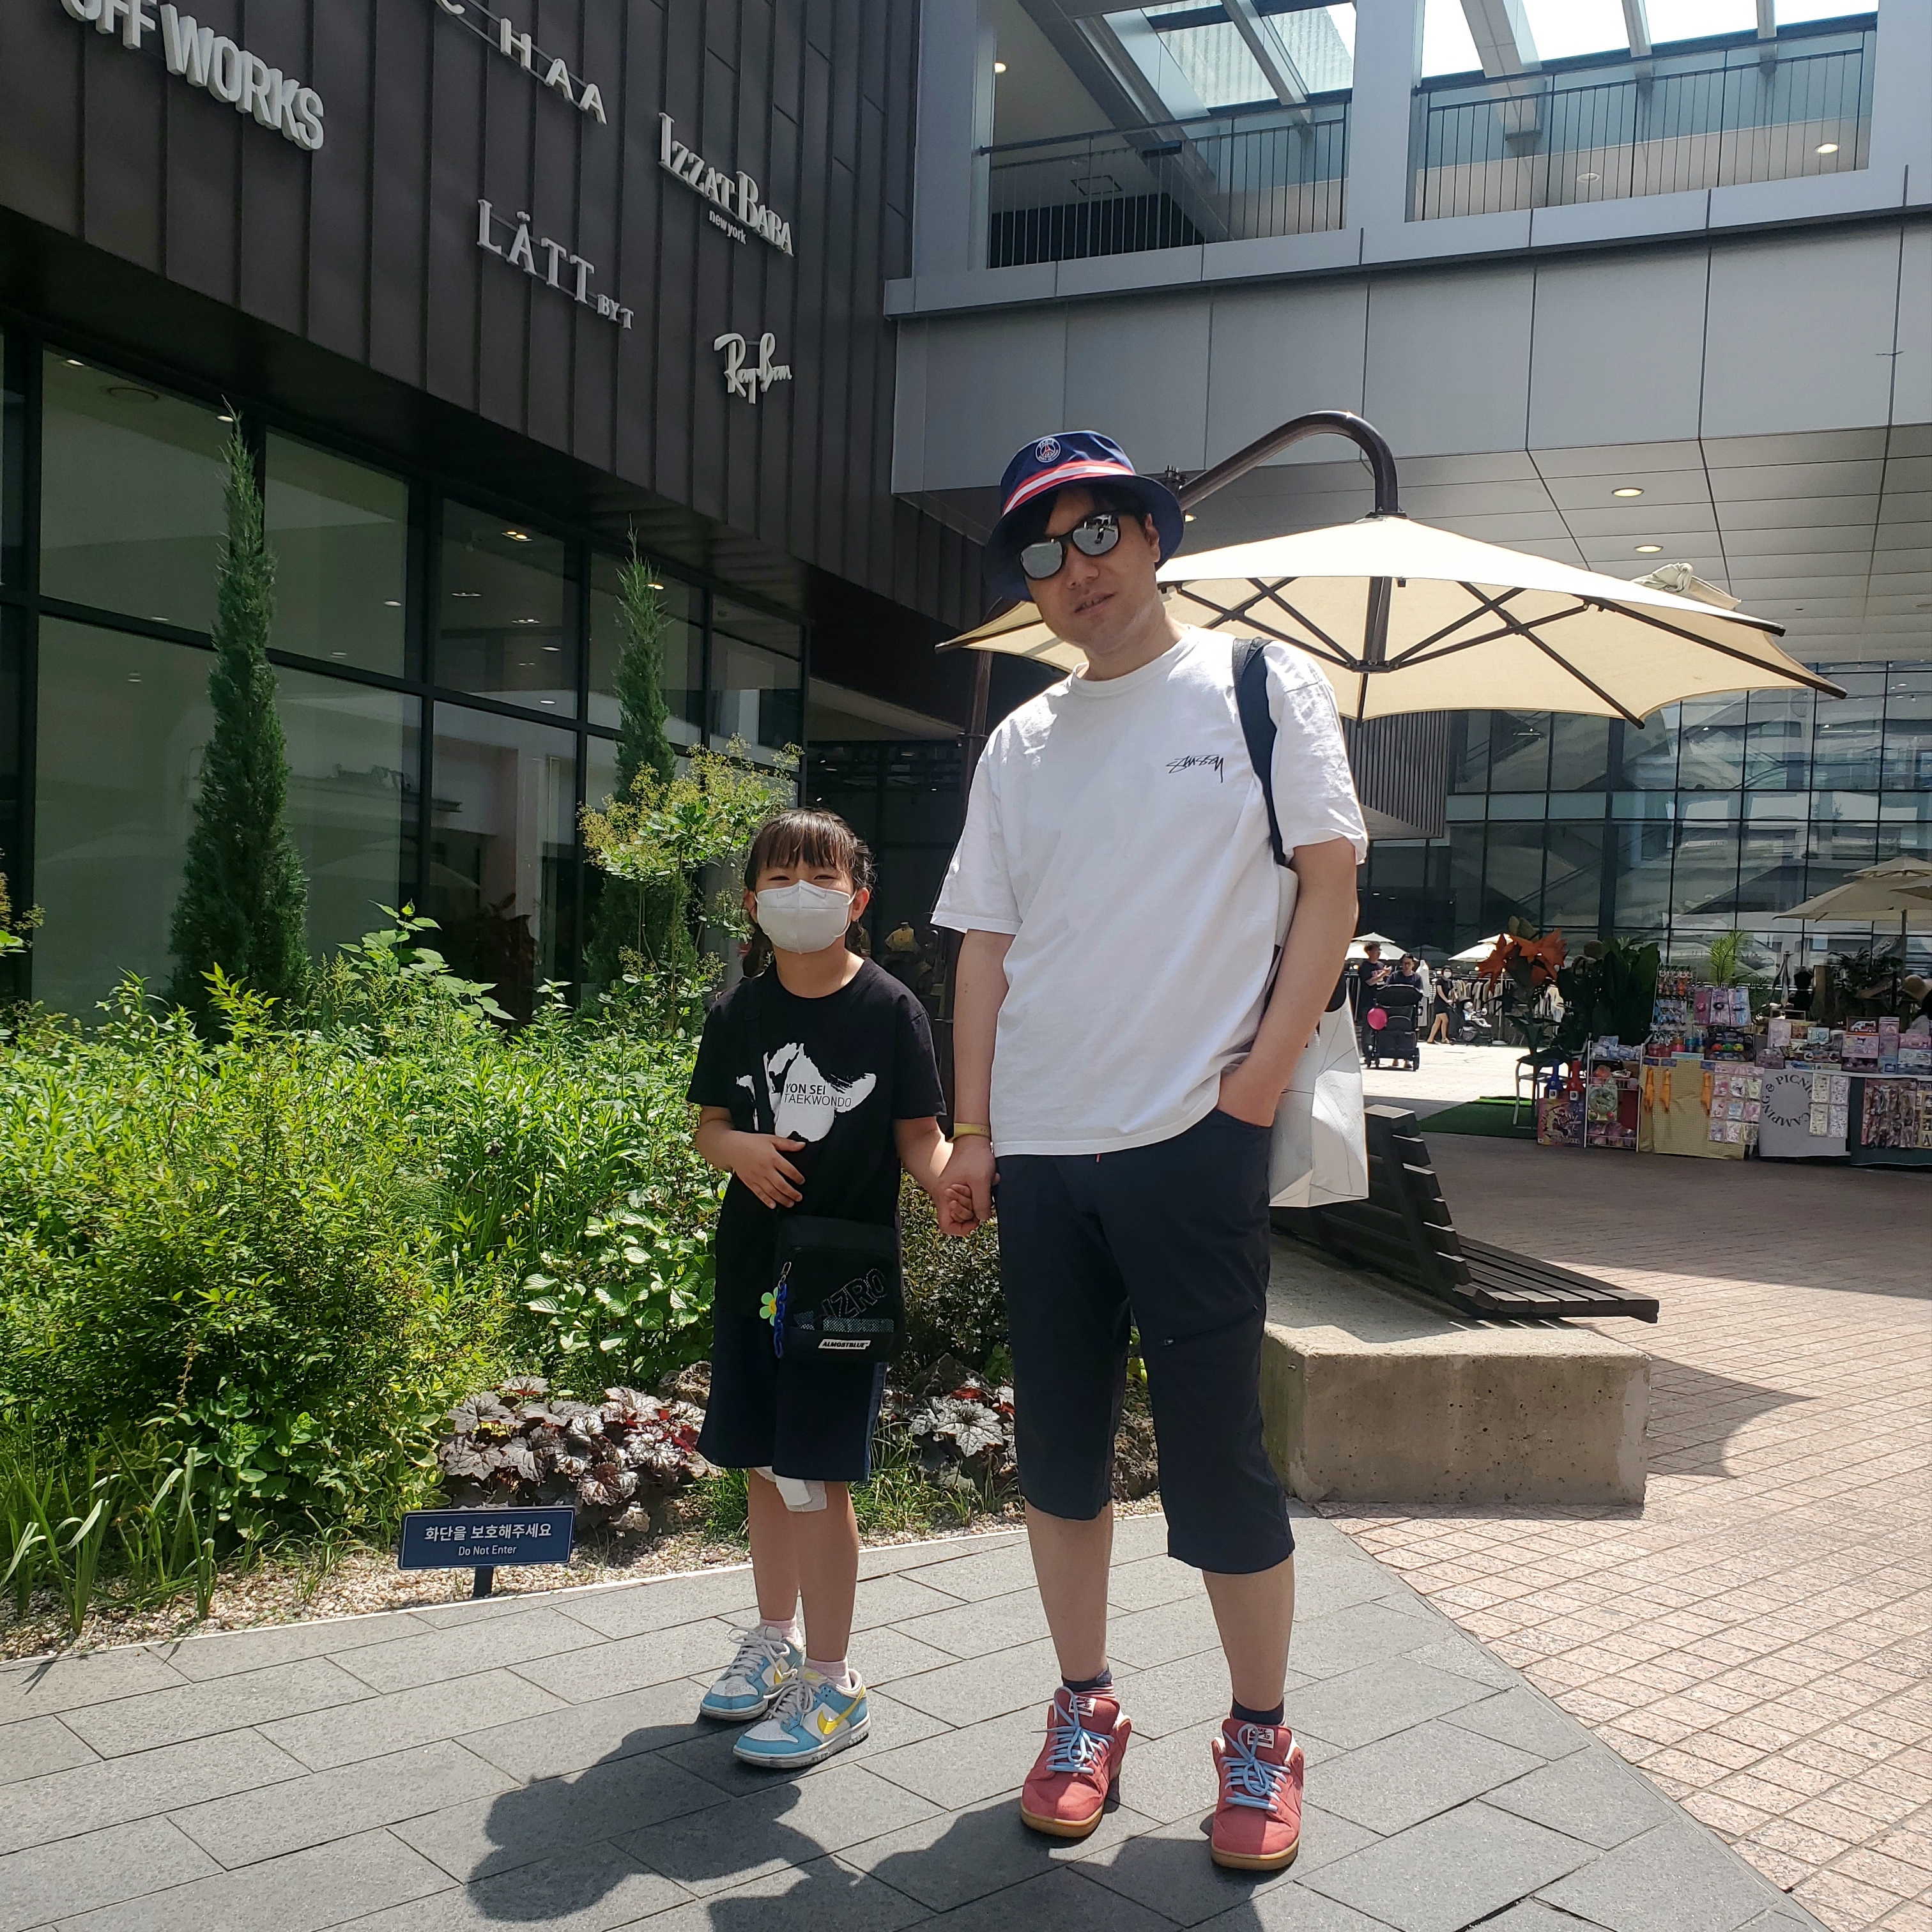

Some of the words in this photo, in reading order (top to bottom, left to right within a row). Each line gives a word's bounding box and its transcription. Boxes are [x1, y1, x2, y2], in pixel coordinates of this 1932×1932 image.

[160, 4, 324, 151] WORKS
[786, 1084, 806, 1094] YON
[809, 1085, 826, 1095] SEI
[785, 1094, 852, 1107] TAEKWONDO
[424, 1526, 467, 1542] 화단을
[470, 1523, 552, 1540] 보호해주세요
[458, 1546, 471, 1556] Do
[473, 1545, 489, 1555] Not
[491, 1545, 517, 1554] Enter
